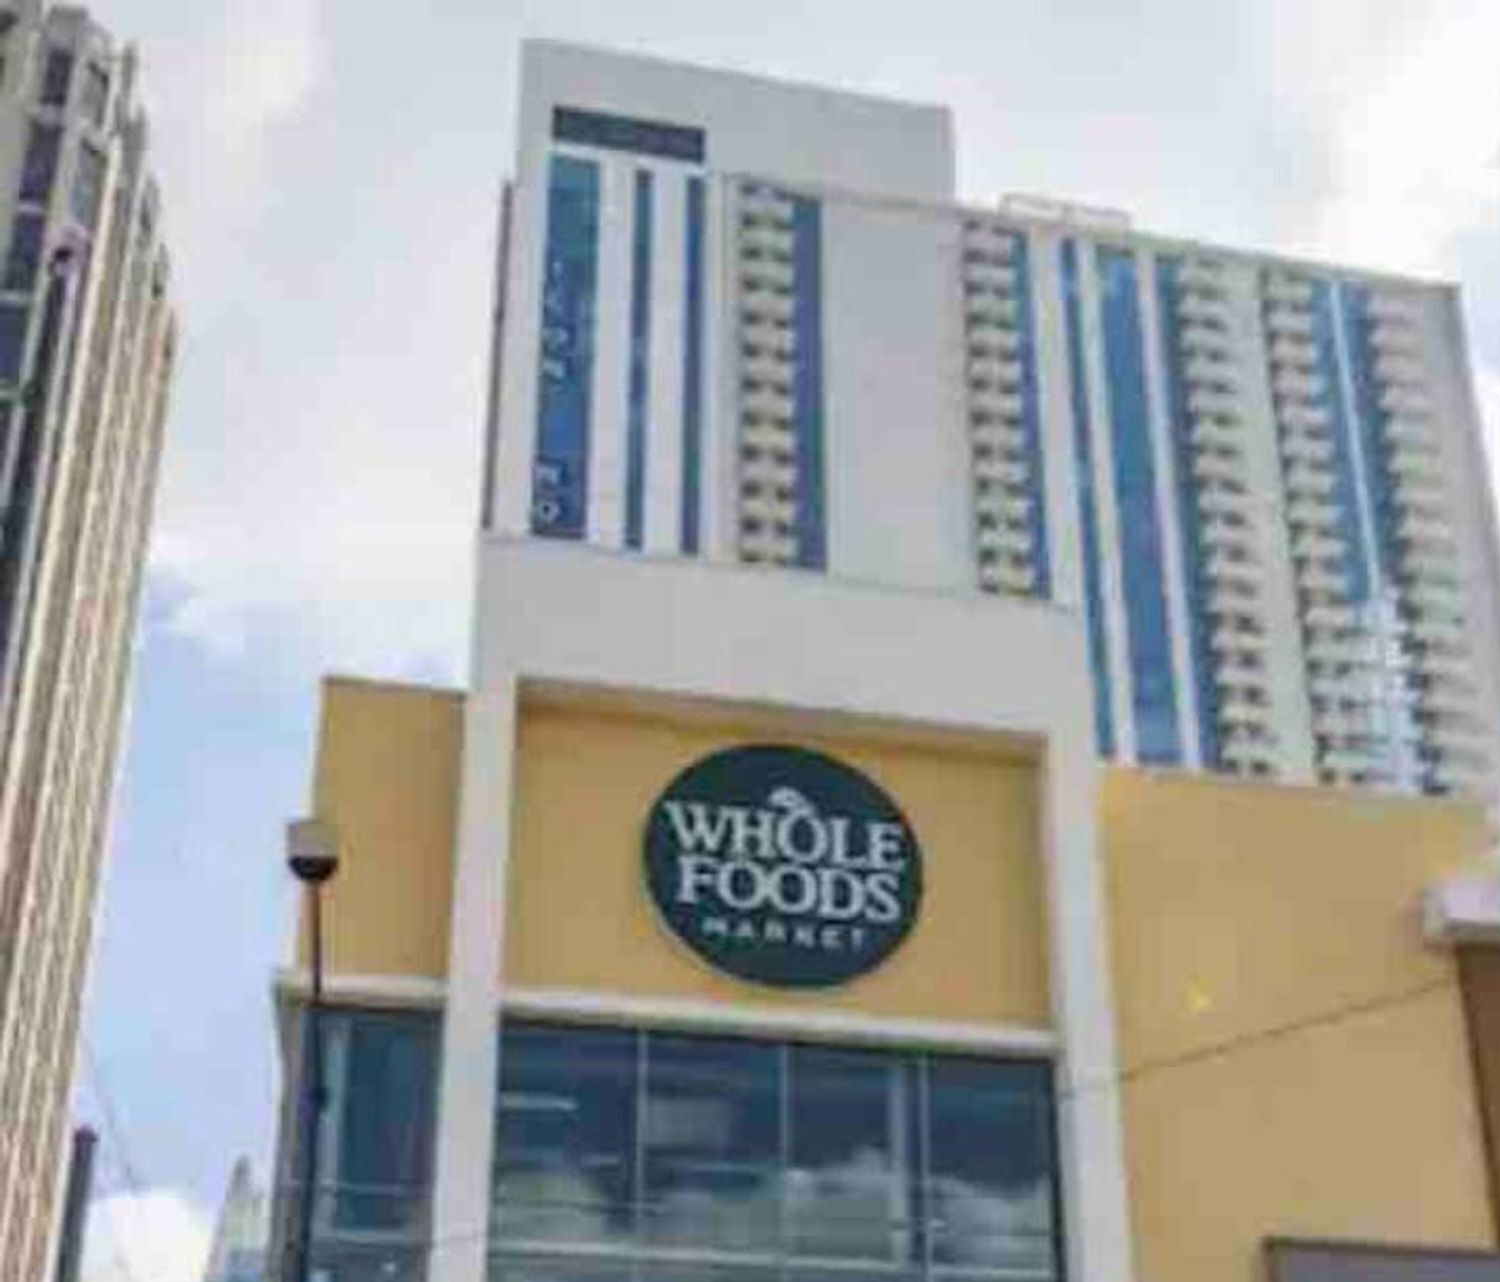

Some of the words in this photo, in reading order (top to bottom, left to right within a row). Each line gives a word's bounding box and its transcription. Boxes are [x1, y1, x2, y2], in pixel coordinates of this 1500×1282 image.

[664, 800, 904, 872] WHOLE
[678, 855, 901, 923] FOODS
[702, 914, 867, 949] MARKET
